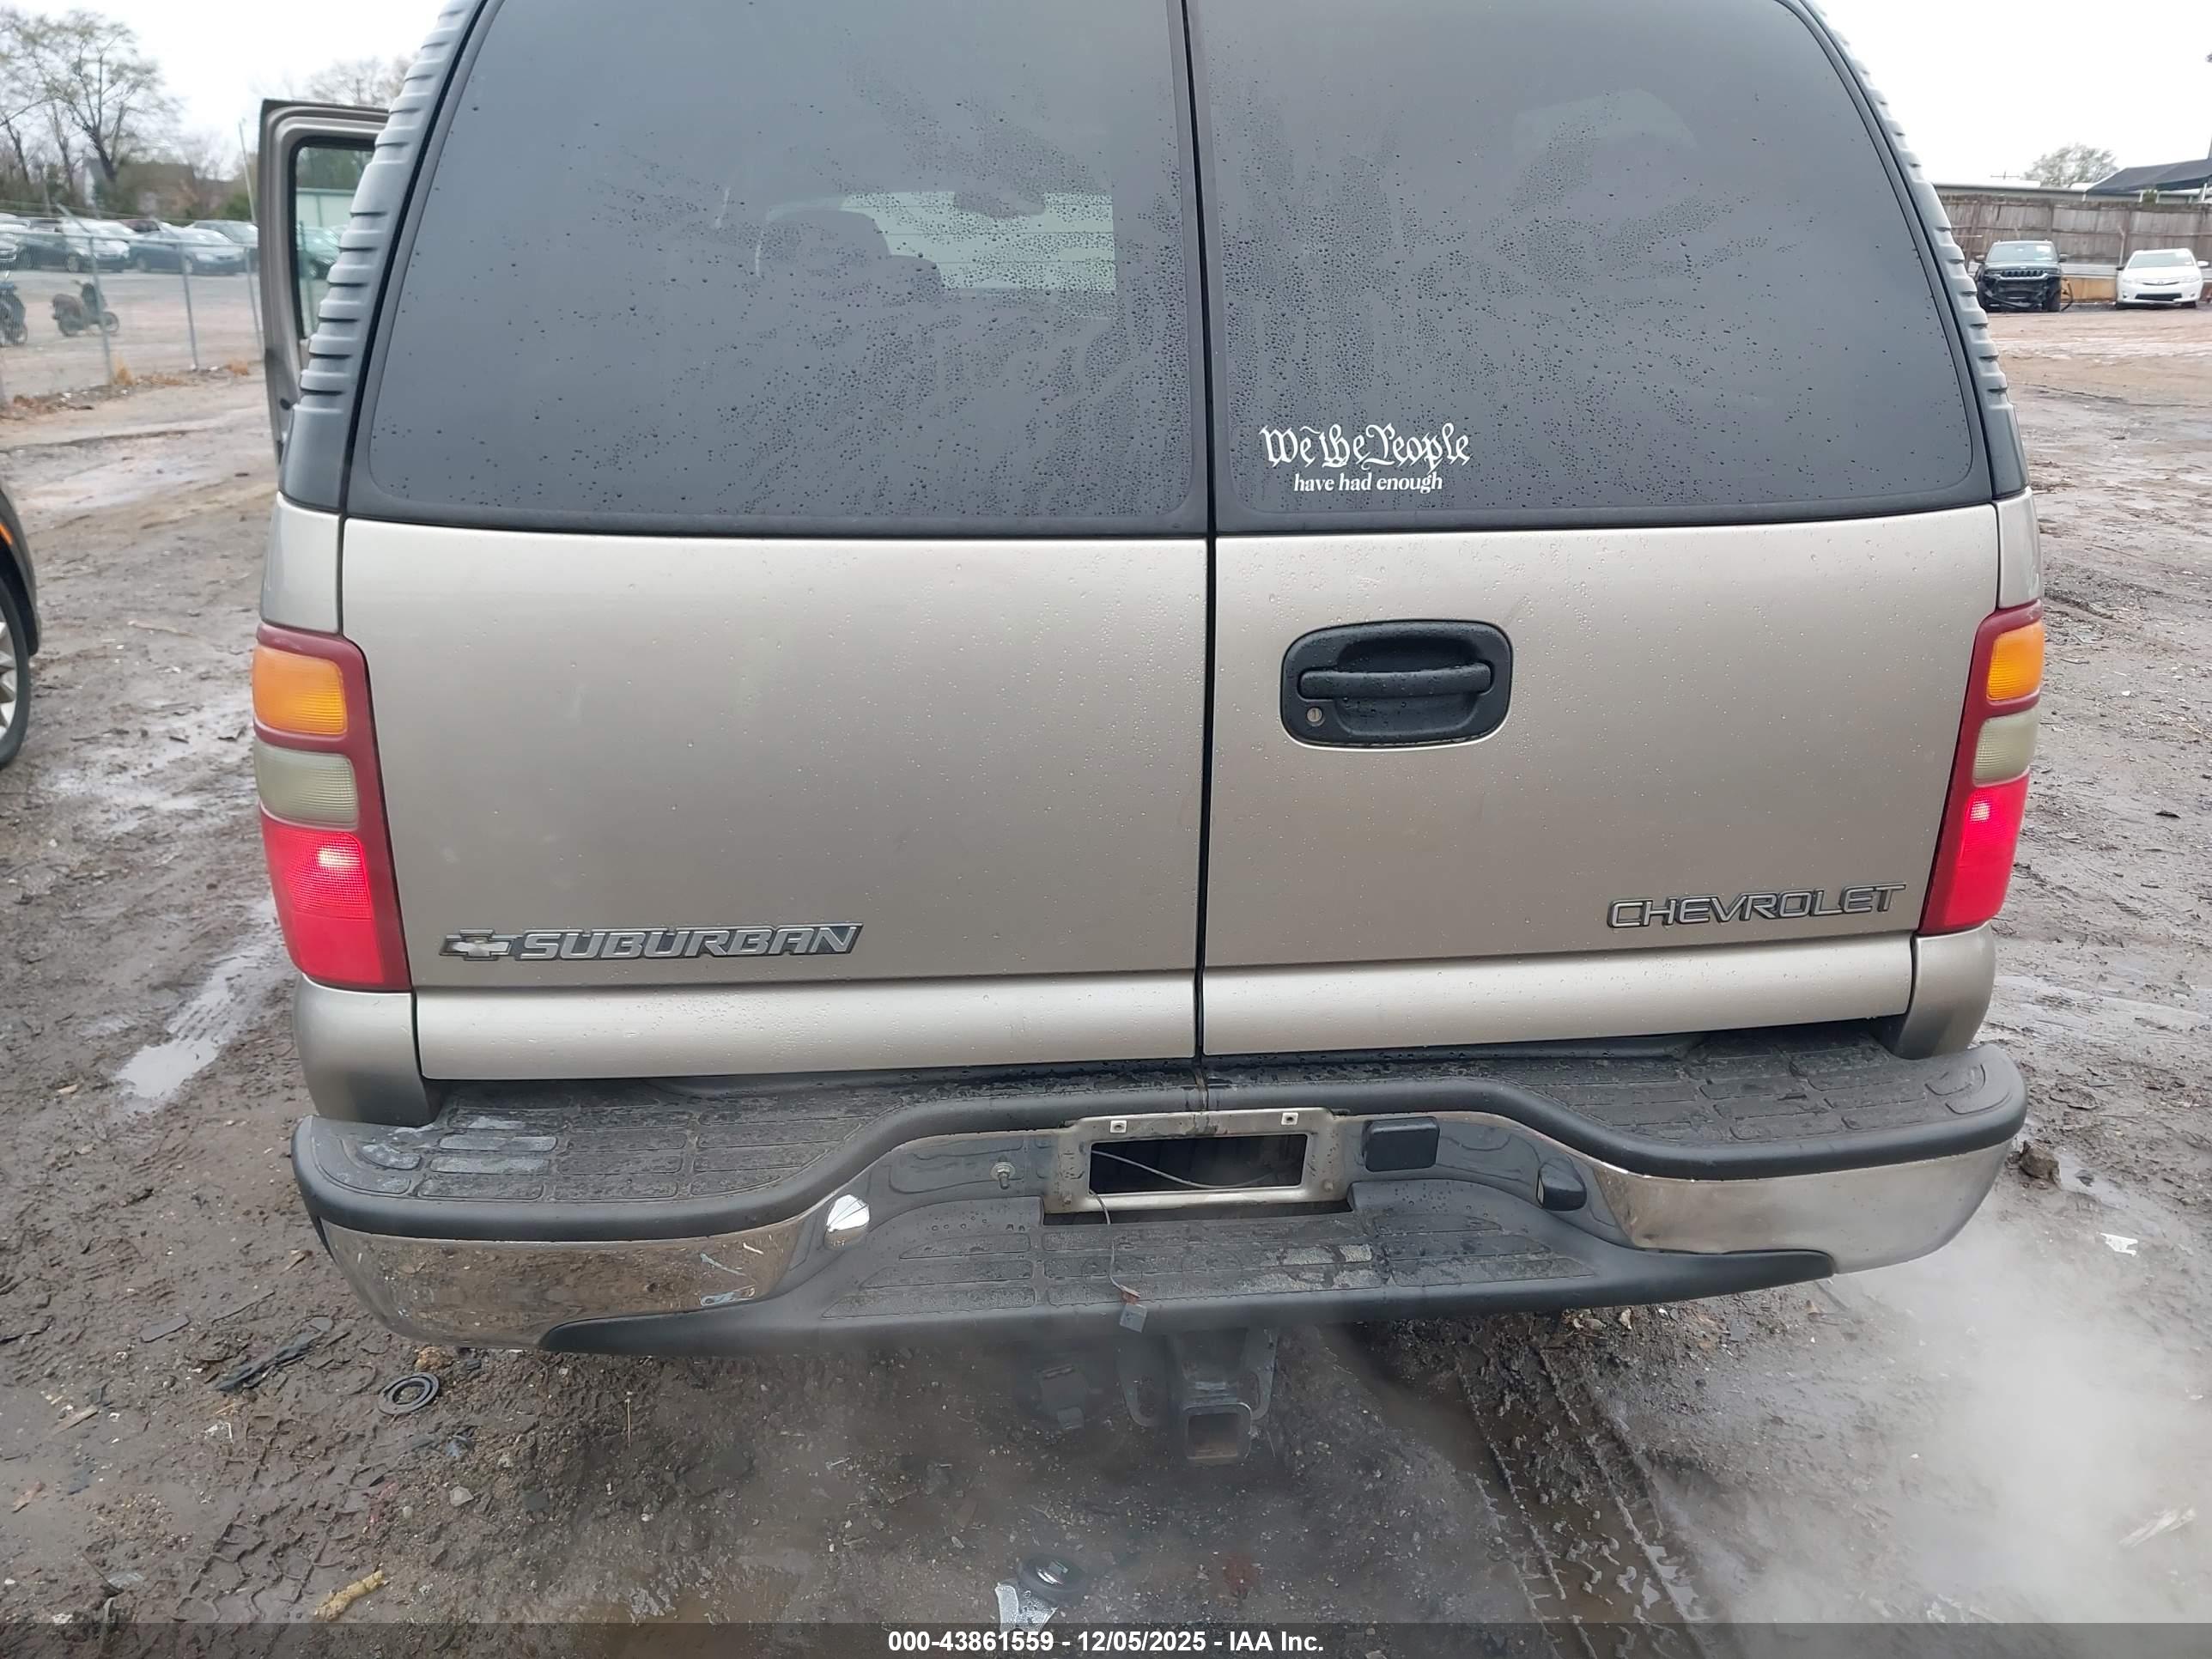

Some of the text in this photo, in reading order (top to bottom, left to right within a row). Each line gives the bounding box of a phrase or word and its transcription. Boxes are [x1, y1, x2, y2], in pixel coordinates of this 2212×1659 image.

[1260, 424, 1316, 467] We
[1361, 422, 1474, 474] People
[1294, 471, 1443, 494] have had enough
[1607, 883, 1906, 928] CHEVROLET
[516, 923, 862, 960] SUBURBAN
